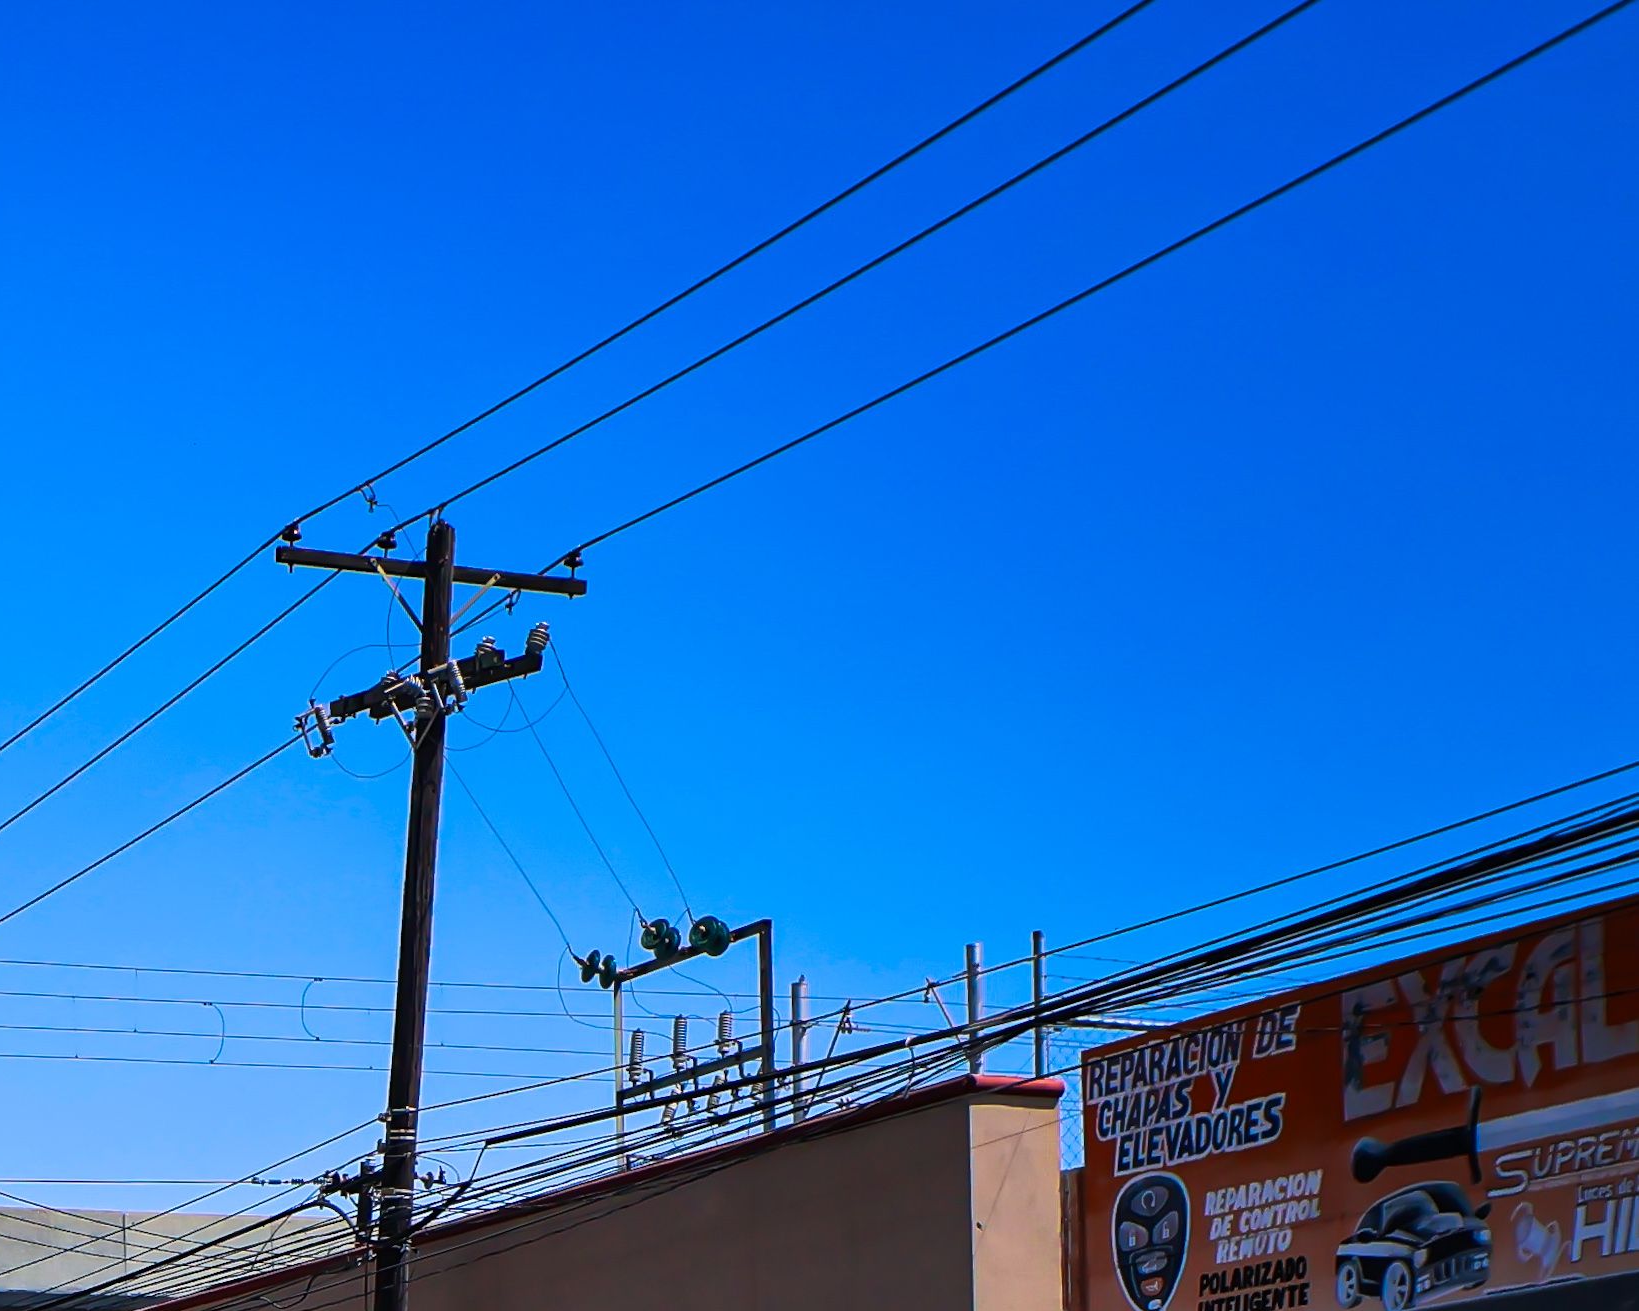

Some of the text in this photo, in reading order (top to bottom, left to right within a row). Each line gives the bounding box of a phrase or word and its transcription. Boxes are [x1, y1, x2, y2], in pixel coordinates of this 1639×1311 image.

[1341, 917, 1639, 1121] EXCAL
[1087, 1002, 1301, 1105] REPARACION DE
[1096, 1063, 1237, 1142] CHAPAS Y
[1114, 1092, 1286, 1177] ELEVADORES
[1204, 1169, 1323, 1216] REPARACION
[1209, 1198, 1322, 1240] DE CONTROL
[1199, 1256, 1308, 1297] POLARIZADO
[1216, 1227, 1293, 1264] REMOTO
